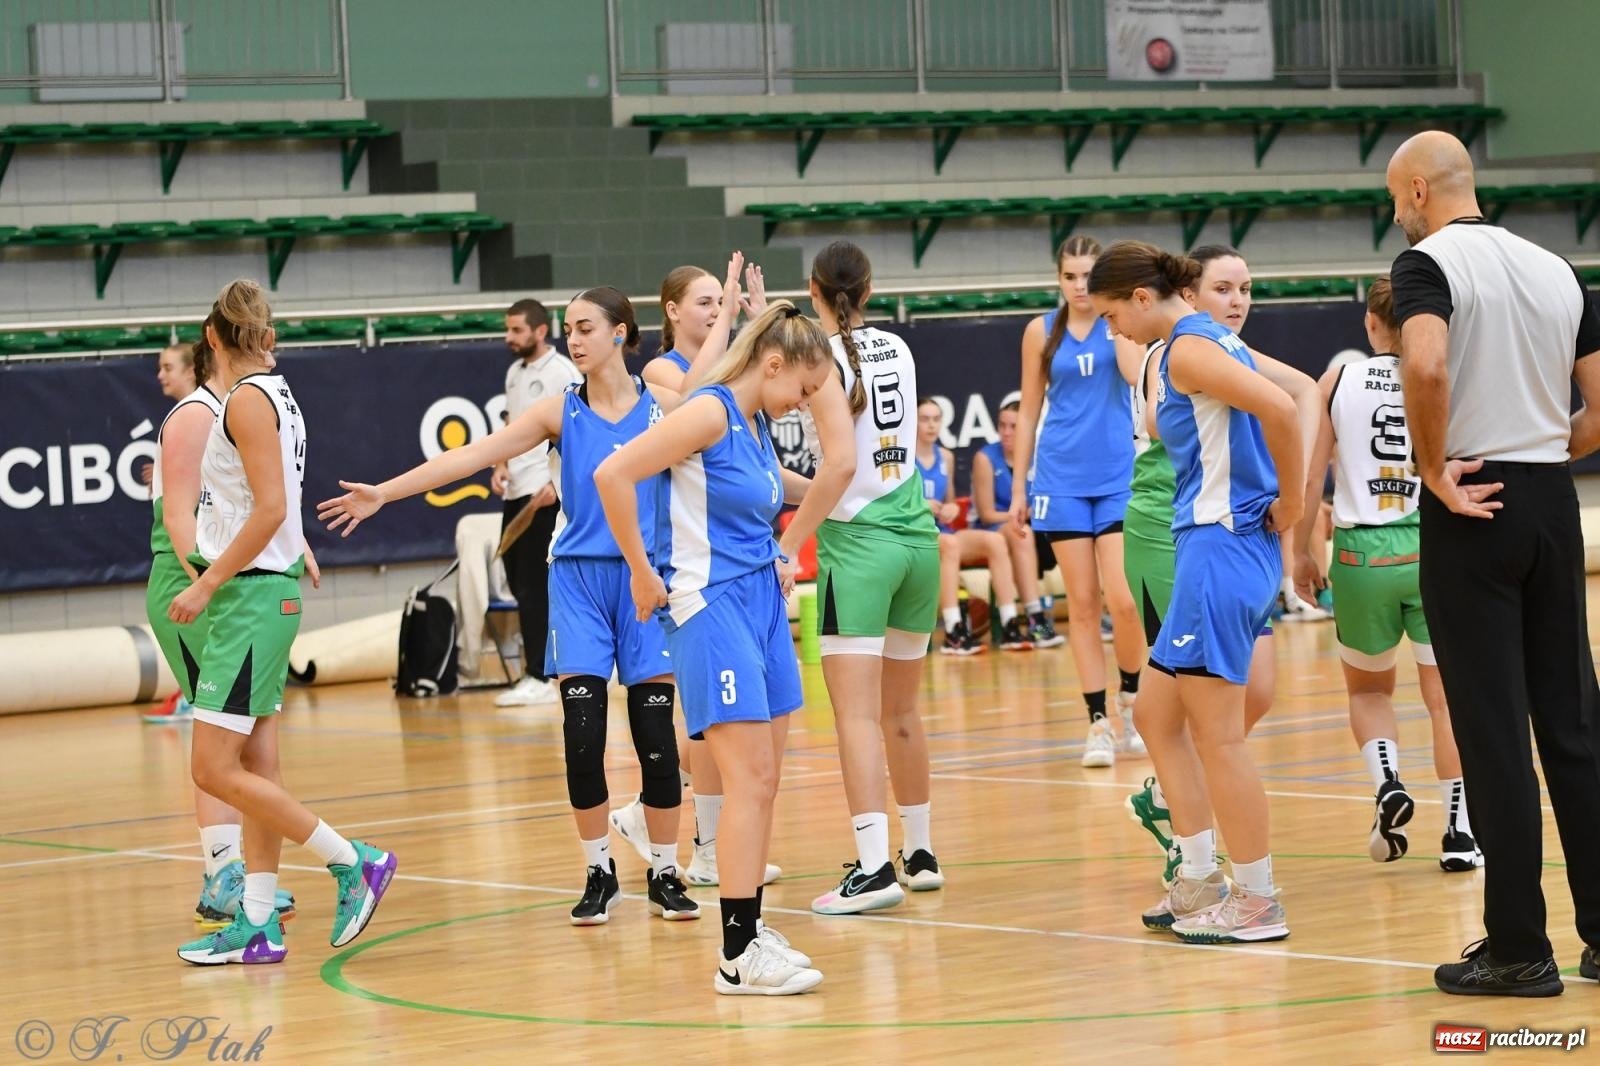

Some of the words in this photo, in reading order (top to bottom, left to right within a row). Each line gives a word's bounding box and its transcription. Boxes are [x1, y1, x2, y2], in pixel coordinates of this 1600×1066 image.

[1076, 353, 1094, 376] 17
[872, 372, 904, 431] 6
[876, 450, 904, 464] SEGET
[1371, 481, 1412, 493] SEGET
[1034, 496, 1050, 520] 17
[720, 669, 736, 705] 3
